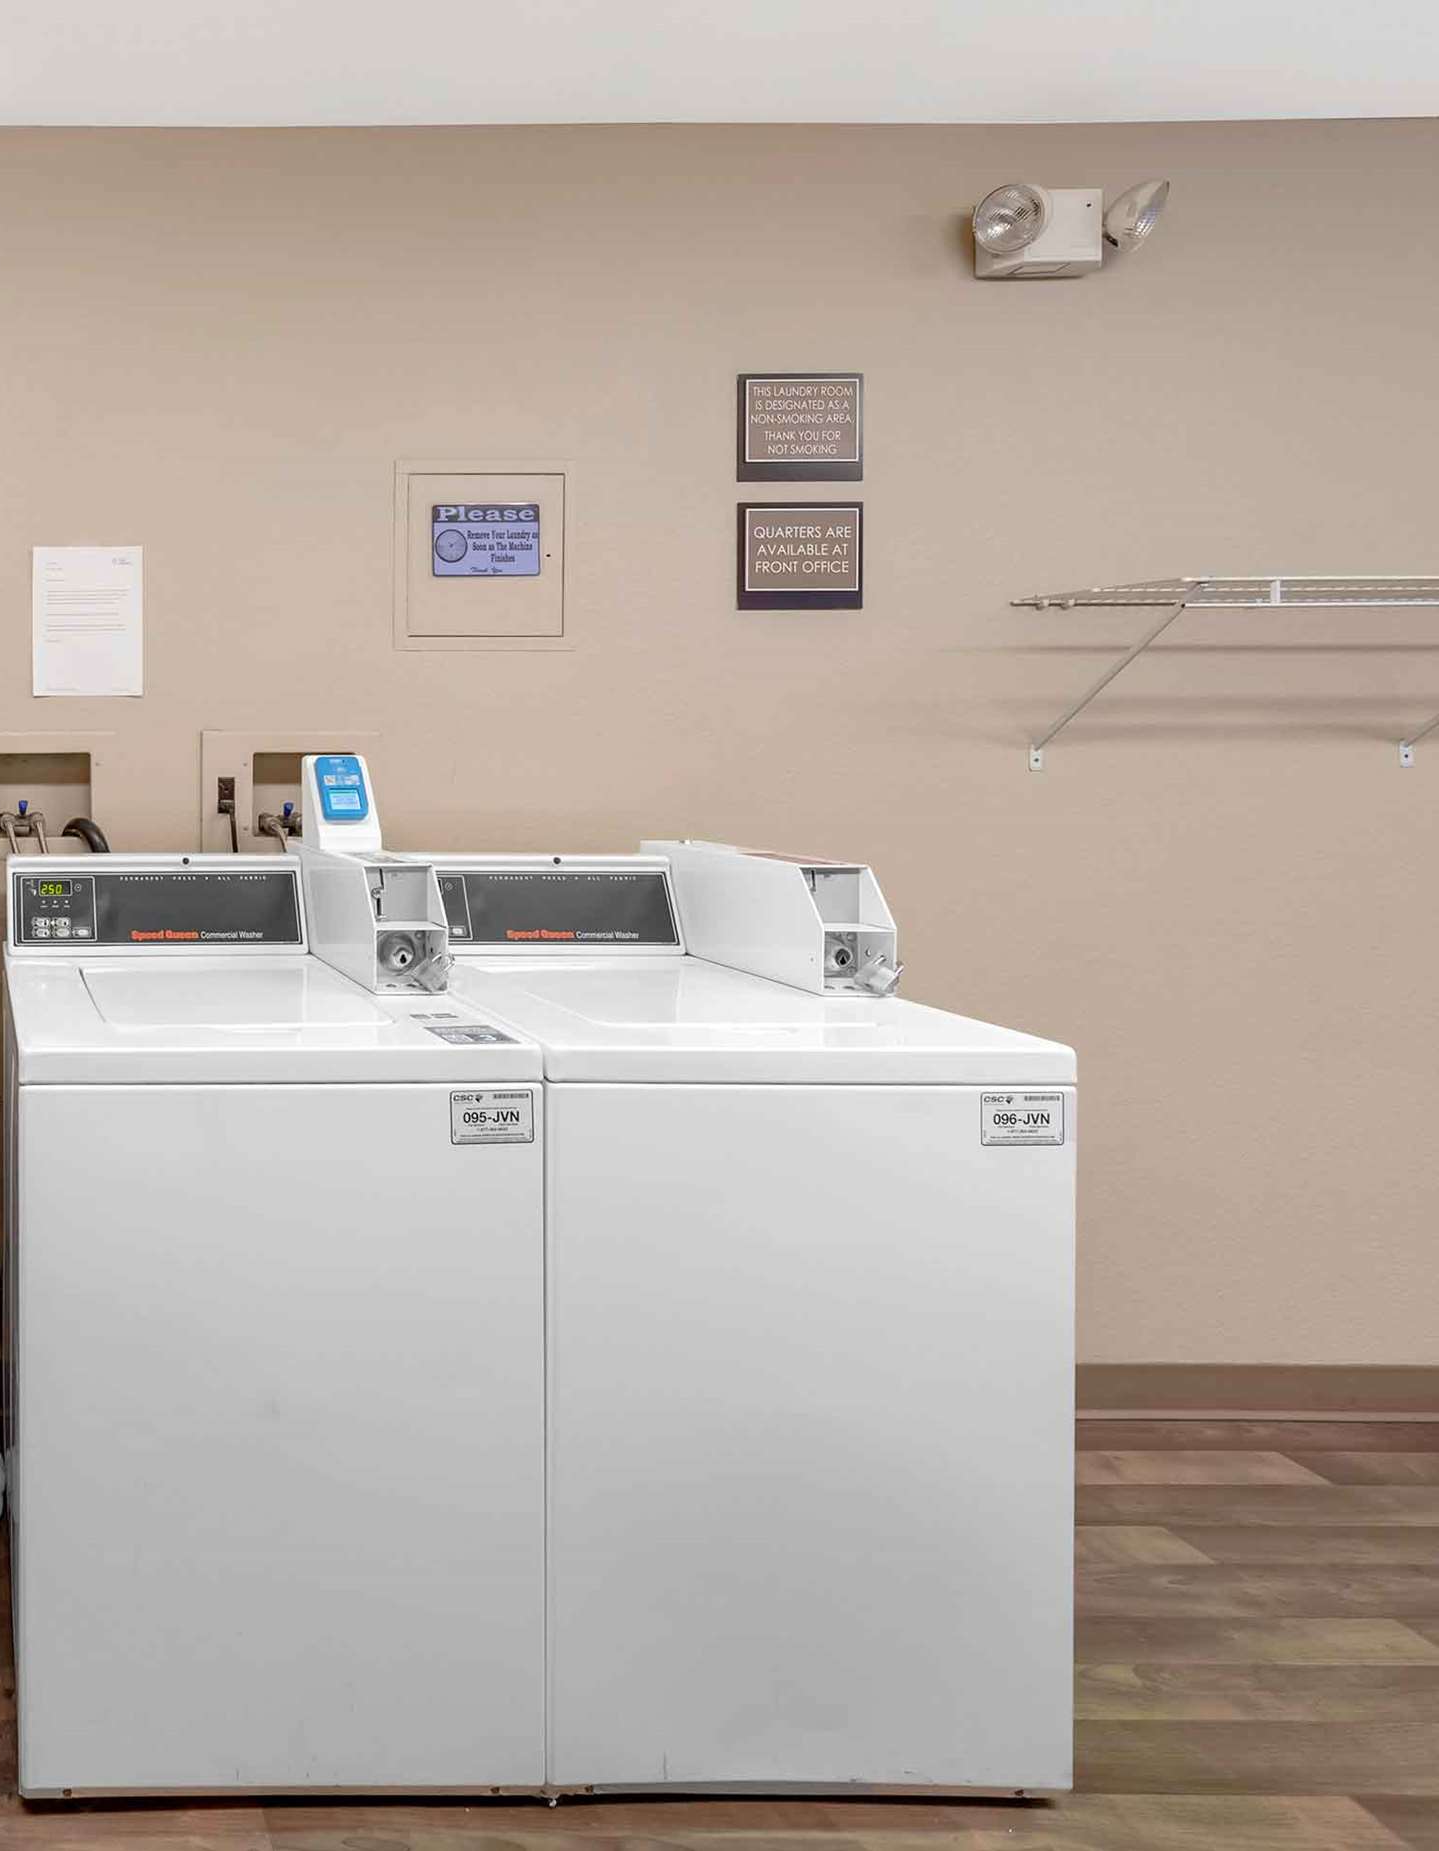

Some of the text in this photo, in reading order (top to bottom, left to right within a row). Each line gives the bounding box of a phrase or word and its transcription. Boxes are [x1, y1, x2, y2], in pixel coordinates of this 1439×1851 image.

[753, 386, 854, 397] THIS LAUNDRY ROOM
[755, 400, 850, 410] IS DESIGNATED AS A
[750, 414, 823, 424] NON-SMOKING
[764, 430, 841, 441] THANK YOU FOR
[768, 444, 837, 455] NOT SMOKING
[436, 506, 535, 521] Please
[753, 526, 852, 539] QUARTERS ARE
[757, 543, 848, 556] AVAILABLE AT
[755, 561, 849, 573] FRONT OFFICE
[200, 930, 238, 939] Commercial
[239, 930, 264, 939] Washer
[453, 1094, 474, 1102] CSC
[983, 1095, 1005, 1103] CSC
[463, 1111, 520, 1124] 095-JVN
[993, 1113, 1050, 1125] 096-JVN
